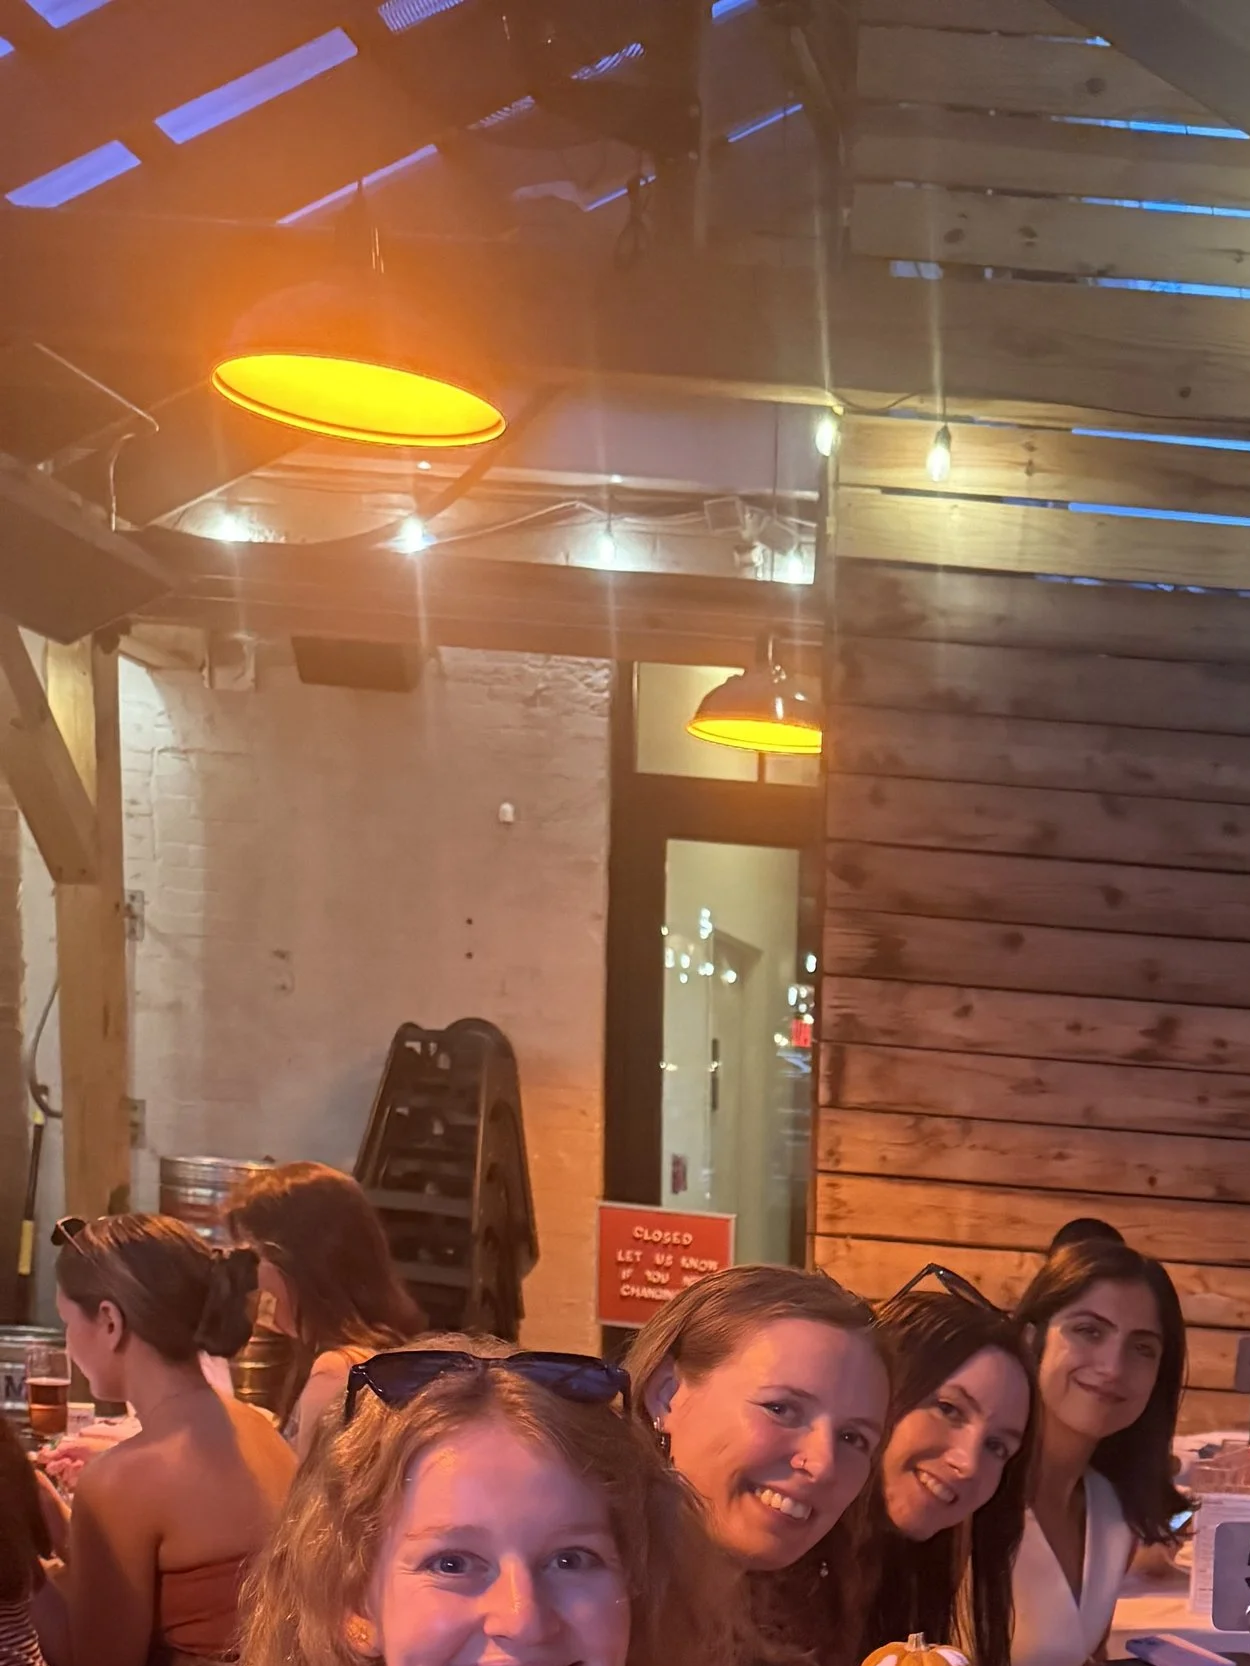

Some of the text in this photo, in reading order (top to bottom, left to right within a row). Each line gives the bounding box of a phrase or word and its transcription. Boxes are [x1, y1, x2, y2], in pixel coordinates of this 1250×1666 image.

[633, 1226, 693, 1245] CLOSED
[617, 1249, 719, 1271] LET US KNOW
[644, 1270, 670, 1283] YOU
